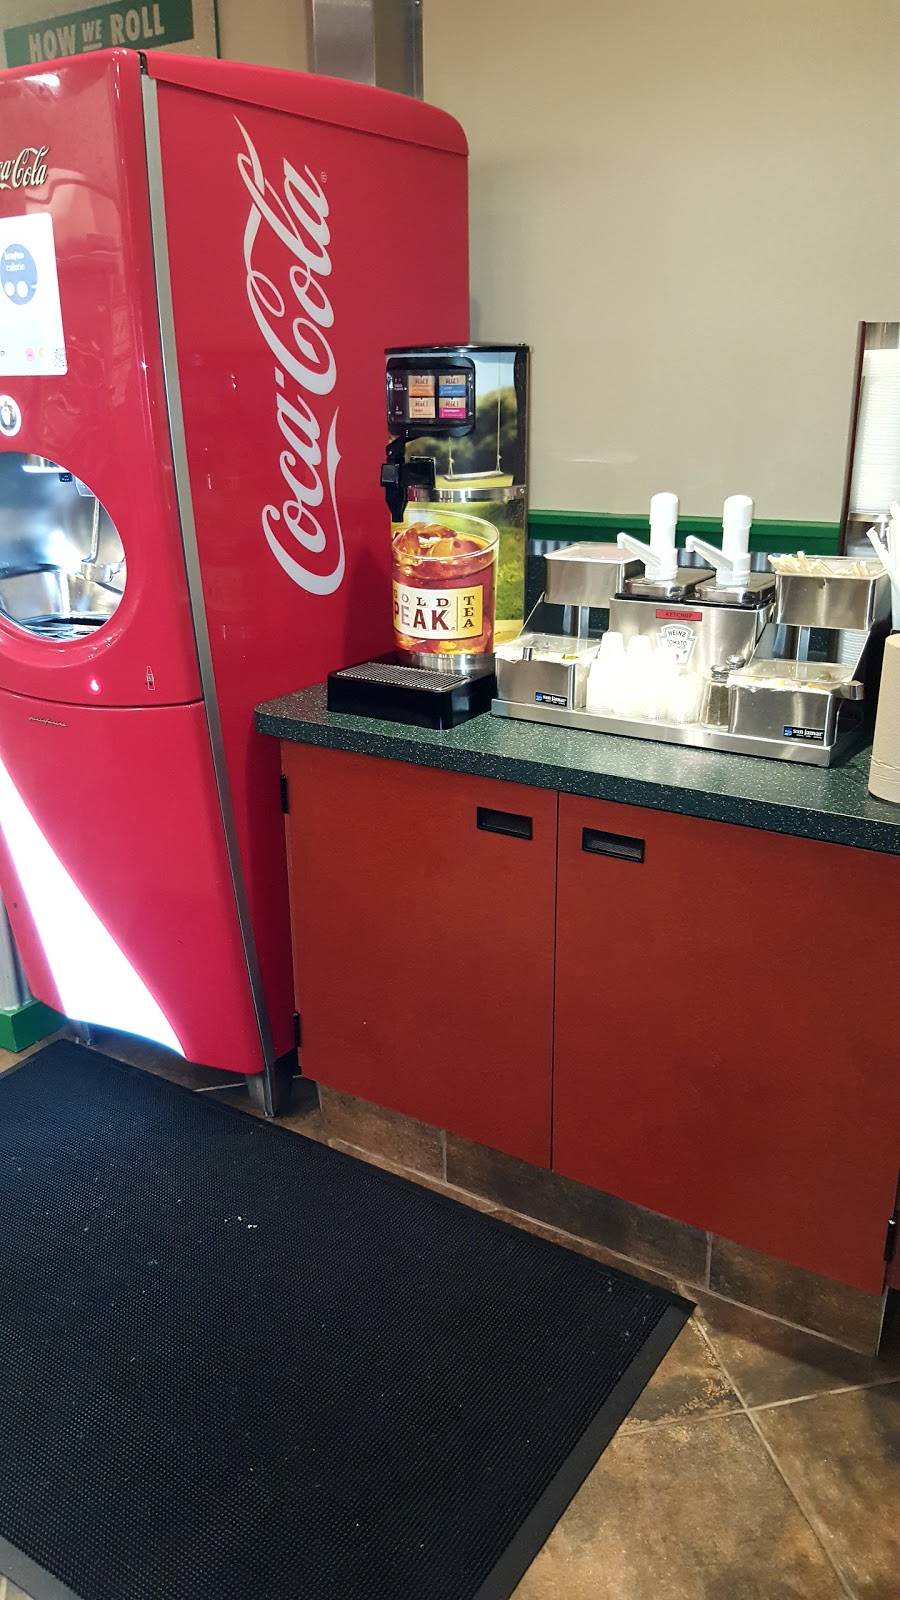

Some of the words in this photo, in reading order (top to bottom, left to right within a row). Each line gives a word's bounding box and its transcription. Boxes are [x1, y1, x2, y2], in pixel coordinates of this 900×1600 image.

[28, 24, 76, 63] HOW
[82, 19, 103, 42] WE
[110, 4, 165, 45] ROLL
[233, 114, 346, 596] Coca-Cola
[394, 601, 450, 630] PEAK
[463, 595, 475, 628] TEA
[667, 630, 687, 638] HEINZ
[804, 729, 824, 737] jamar
